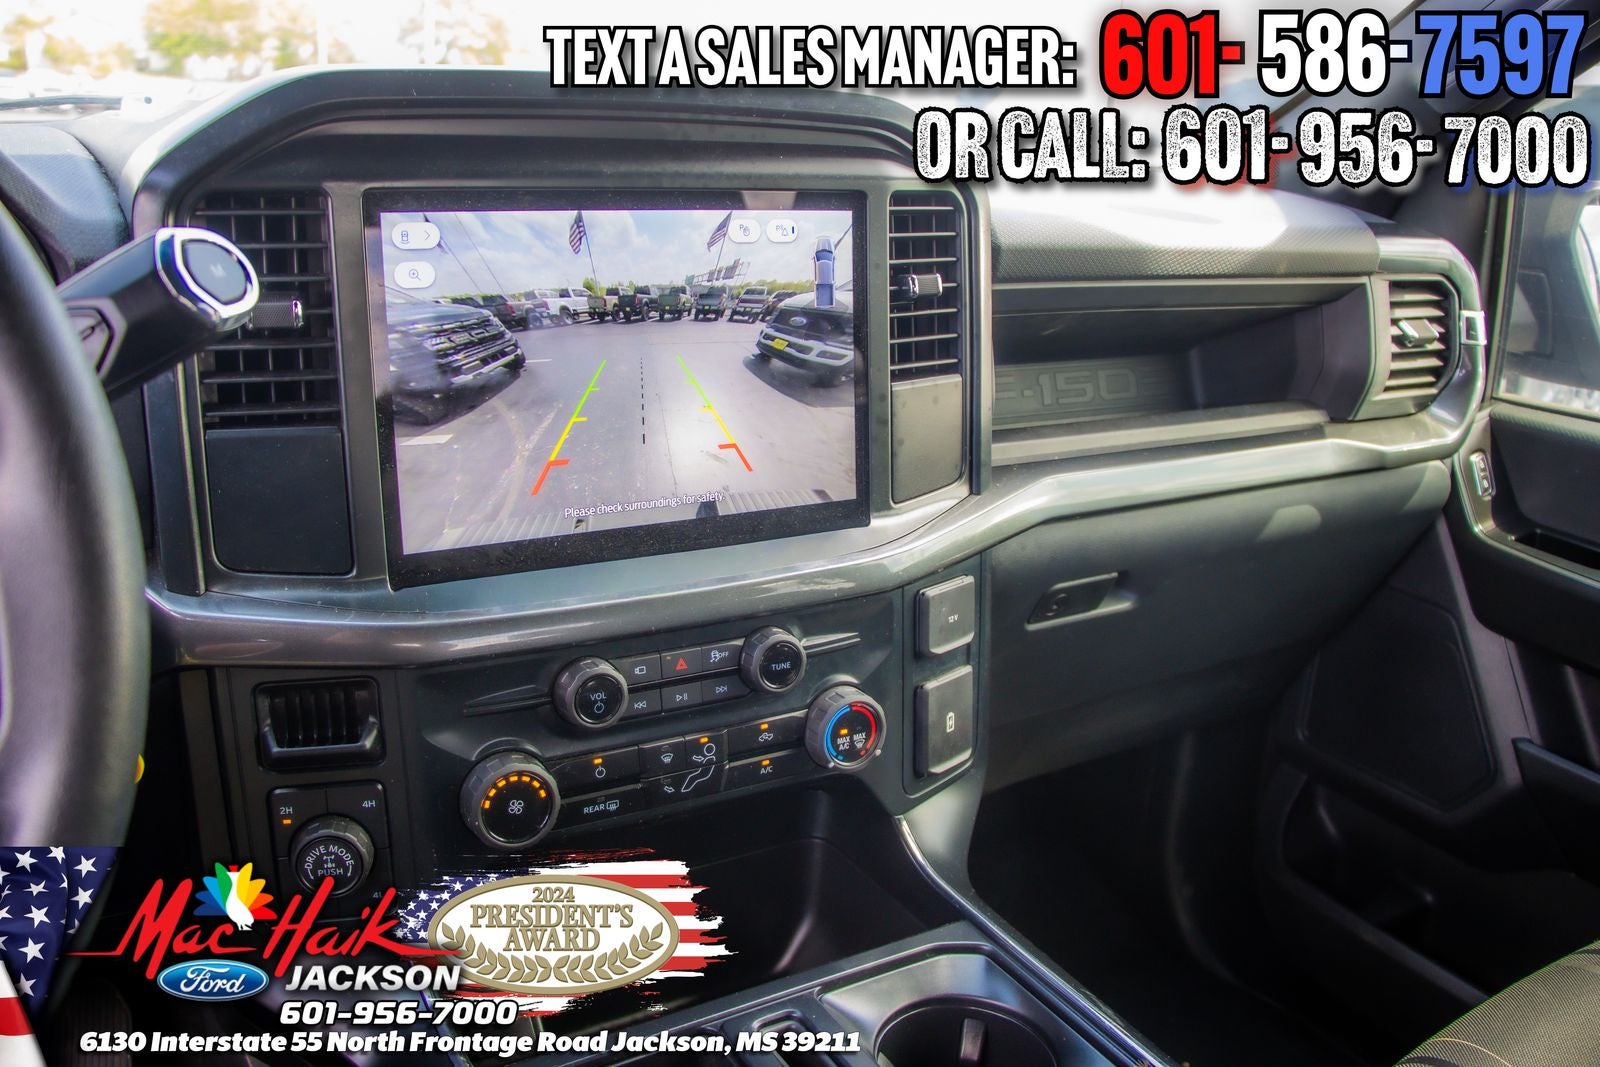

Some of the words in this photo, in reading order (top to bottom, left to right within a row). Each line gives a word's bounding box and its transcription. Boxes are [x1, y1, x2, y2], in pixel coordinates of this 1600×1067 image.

[564, 506, 595, 518] Please
[597, 502, 623, 514] check
[625, 497, 682, 510] surroundings
[683, 494, 696, 504] for
[697, 492, 725, 504] safety.
[771, 661, 791, 671] TUNE
[590, 692, 607, 701] VOL
[837, 736, 850, 744] MAX
[853, 732, 866, 741] MAX
[760, 765, 773, 775] A/C
[362, 800, 376, 808] 4H
[280, 806, 293, 815] 2H
[584, 803, 605, 815] REAR
[304, 845, 327, 870] DRIVE
[328, 844, 355, 867] MODE
[318, 868, 344, 876] PUSH
